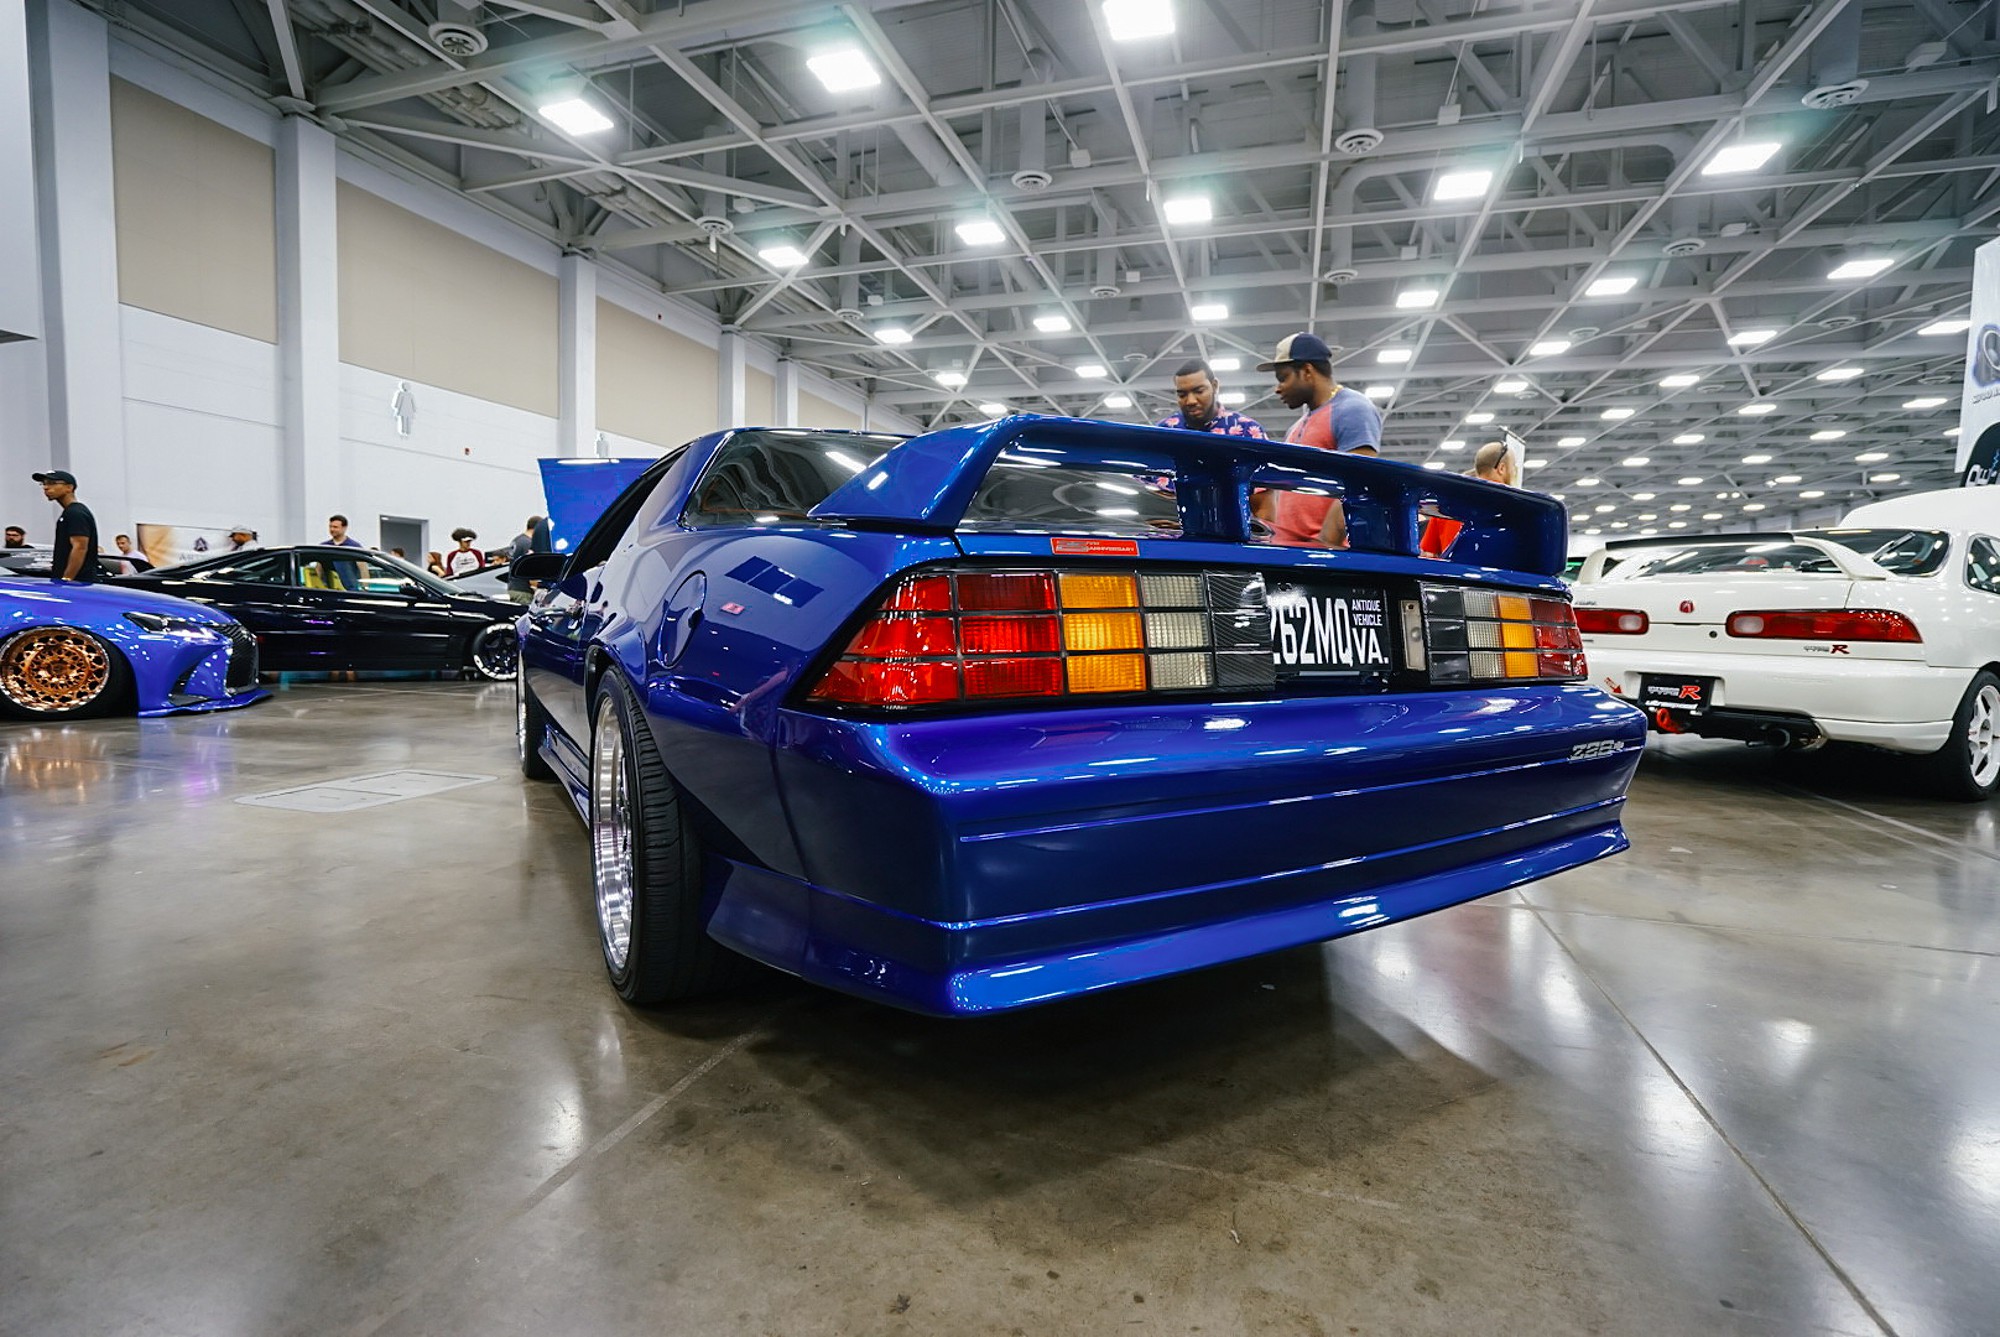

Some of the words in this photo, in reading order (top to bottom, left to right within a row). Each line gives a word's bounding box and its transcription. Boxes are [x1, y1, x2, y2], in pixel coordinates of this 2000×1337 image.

[1352, 599, 1381, 611] ANTIQUE
[1353, 613, 1382, 625] VEHICLE
[1830, 644, 1850, 655] R
[1679, 685, 1701, 700] R
